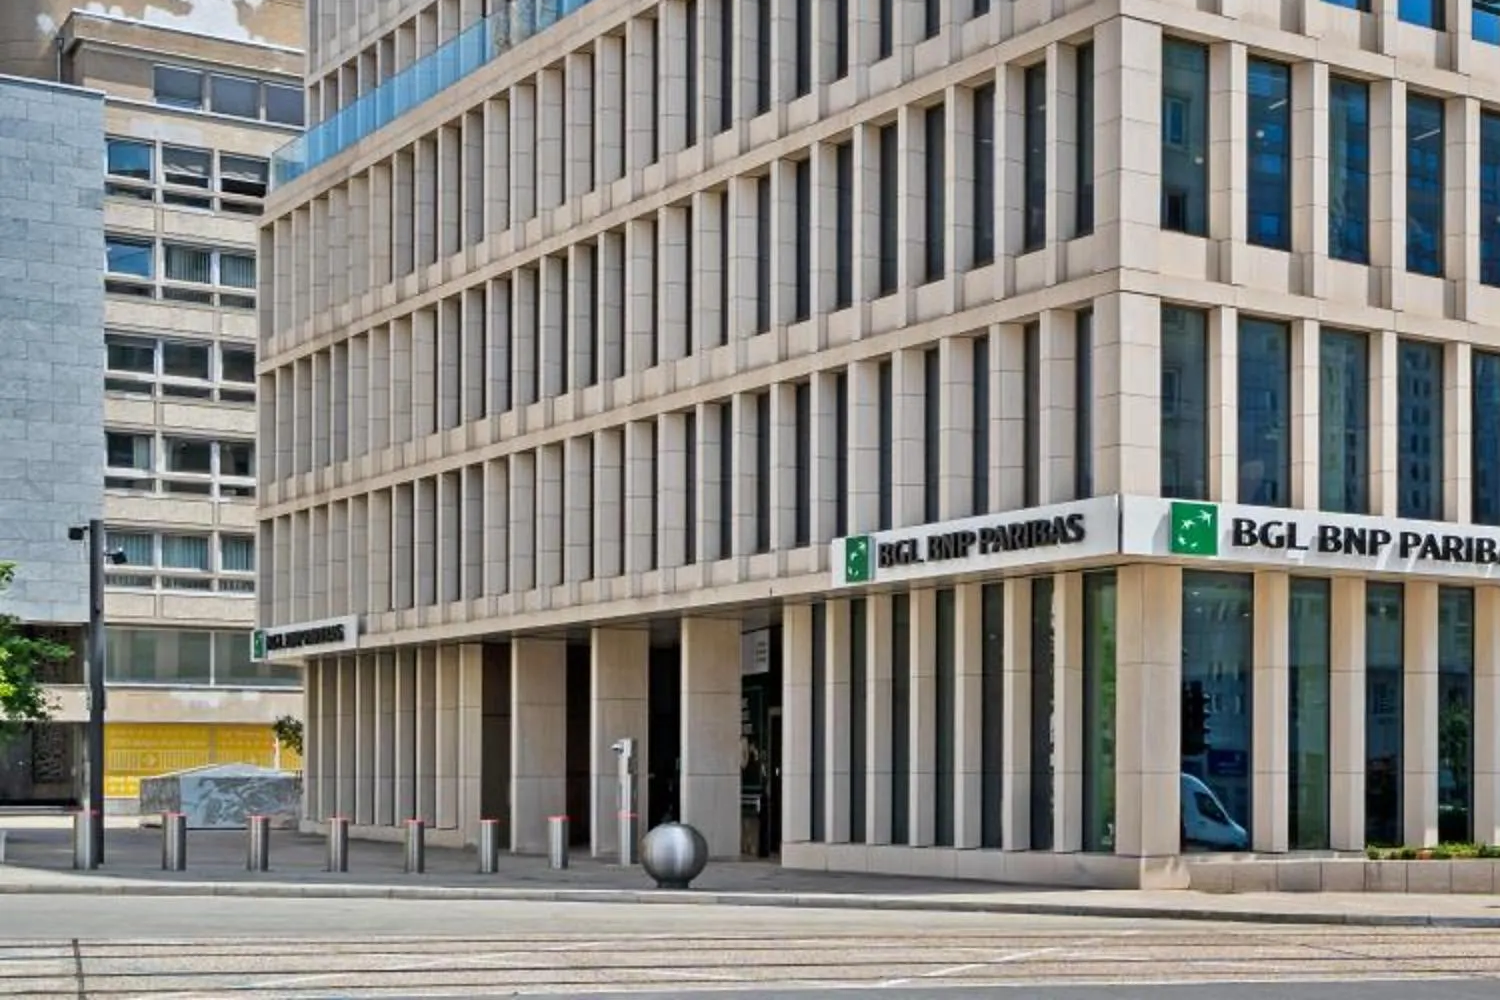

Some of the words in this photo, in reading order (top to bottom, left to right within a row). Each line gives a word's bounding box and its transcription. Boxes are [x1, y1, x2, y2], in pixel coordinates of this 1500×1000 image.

[878, 538, 924, 568] BGL
[927, 530, 976, 561] BNP
[978, 513, 1085, 554] PARIBAS
[1232, 518, 1308, 551] BGL
[1318, 525, 1392, 556] BNP
